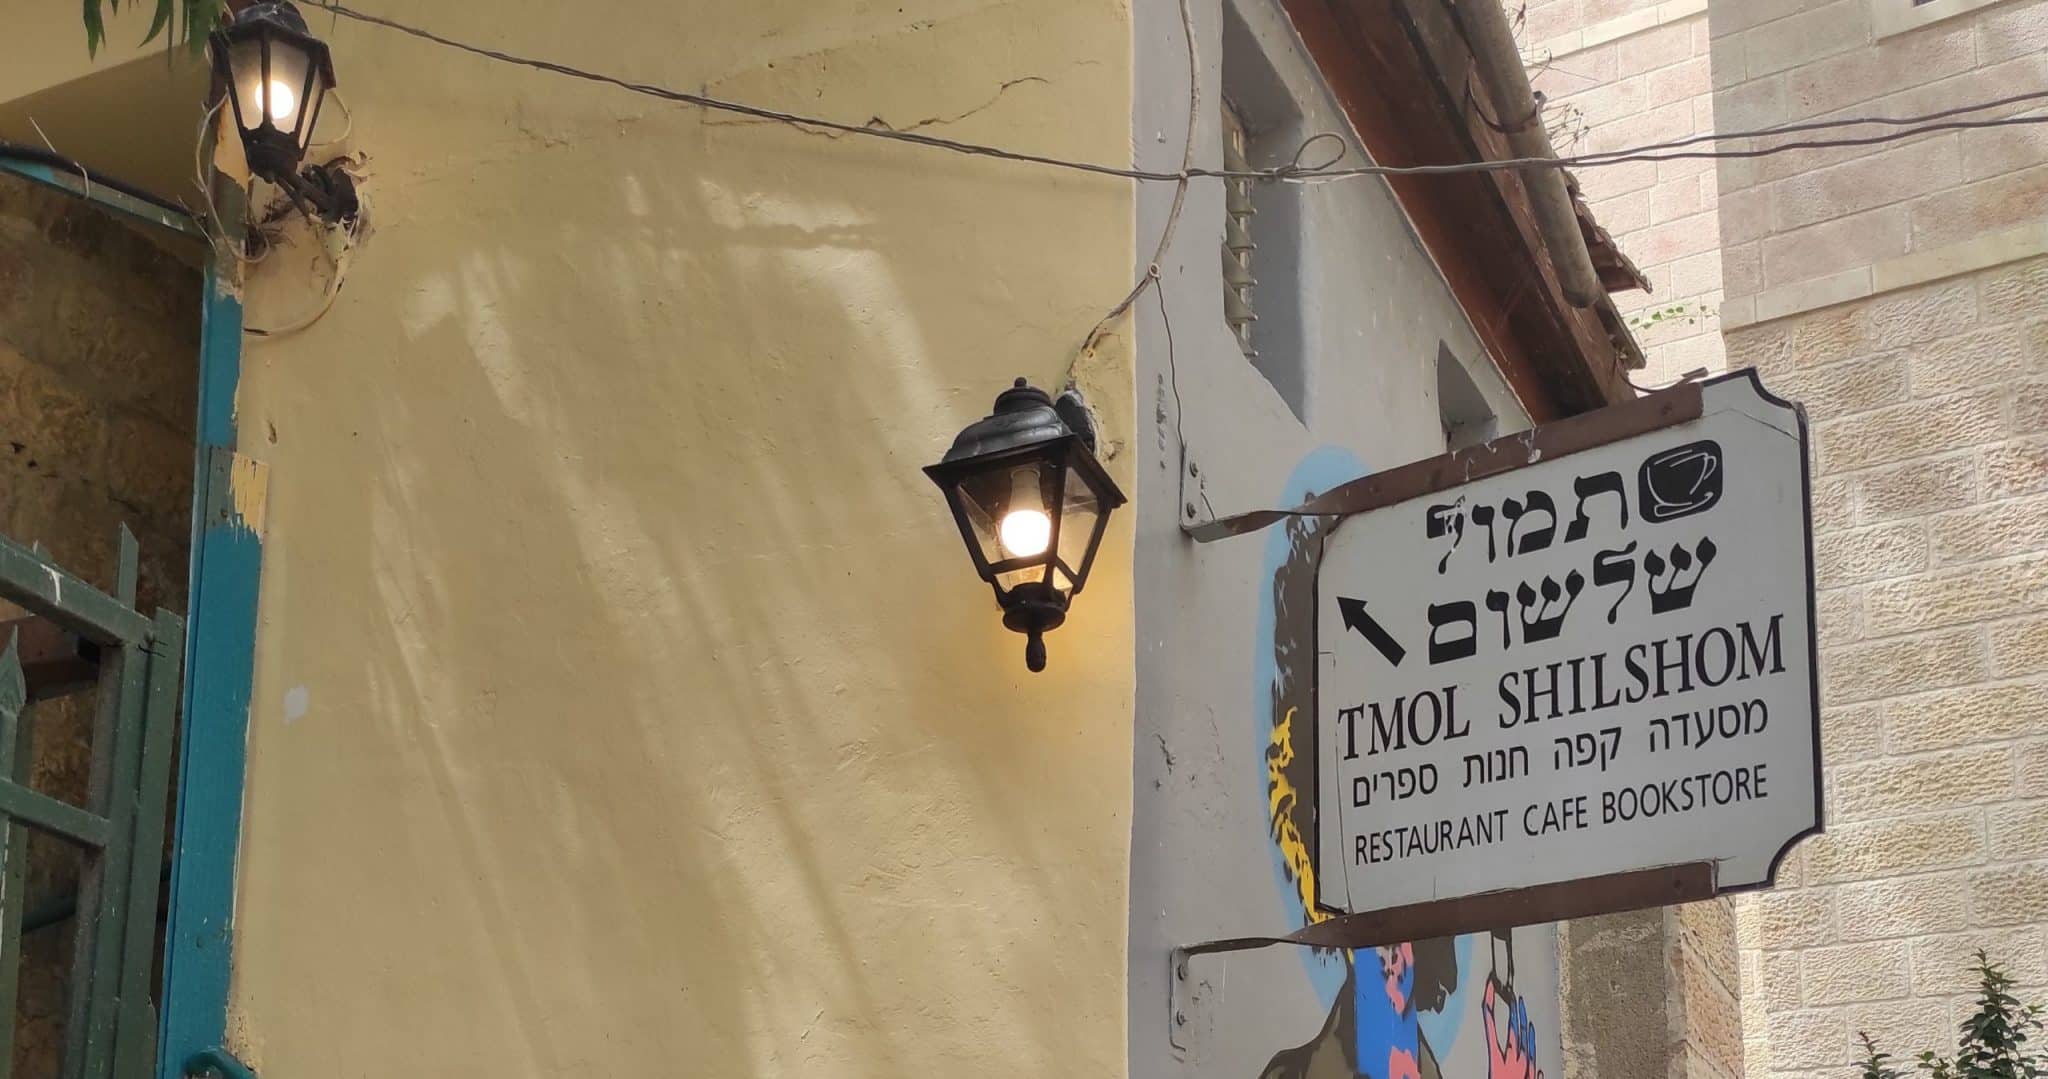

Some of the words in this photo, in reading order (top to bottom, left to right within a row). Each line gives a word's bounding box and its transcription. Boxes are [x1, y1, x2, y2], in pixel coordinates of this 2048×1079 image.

[1426, 470, 1629, 575] תמול
[1427, 535, 1717, 666] שלשום
[1337, 684, 1471, 761] TMOL
[1498, 613, 1787, 729] SHILSHOM
[1649, 698, 1769, 753] מסעדה
[1352, 763, 1438, 808] ספרים
[1462, 745, 1529, 788] חנות
[1554, 726, 1623, 772] קפה
[1355, 809, 1509, 866] RESTAURANT
[1523, 795, 1588, 837] CAFE
[1602, 763, 1768, 825] BOOKSTORE
